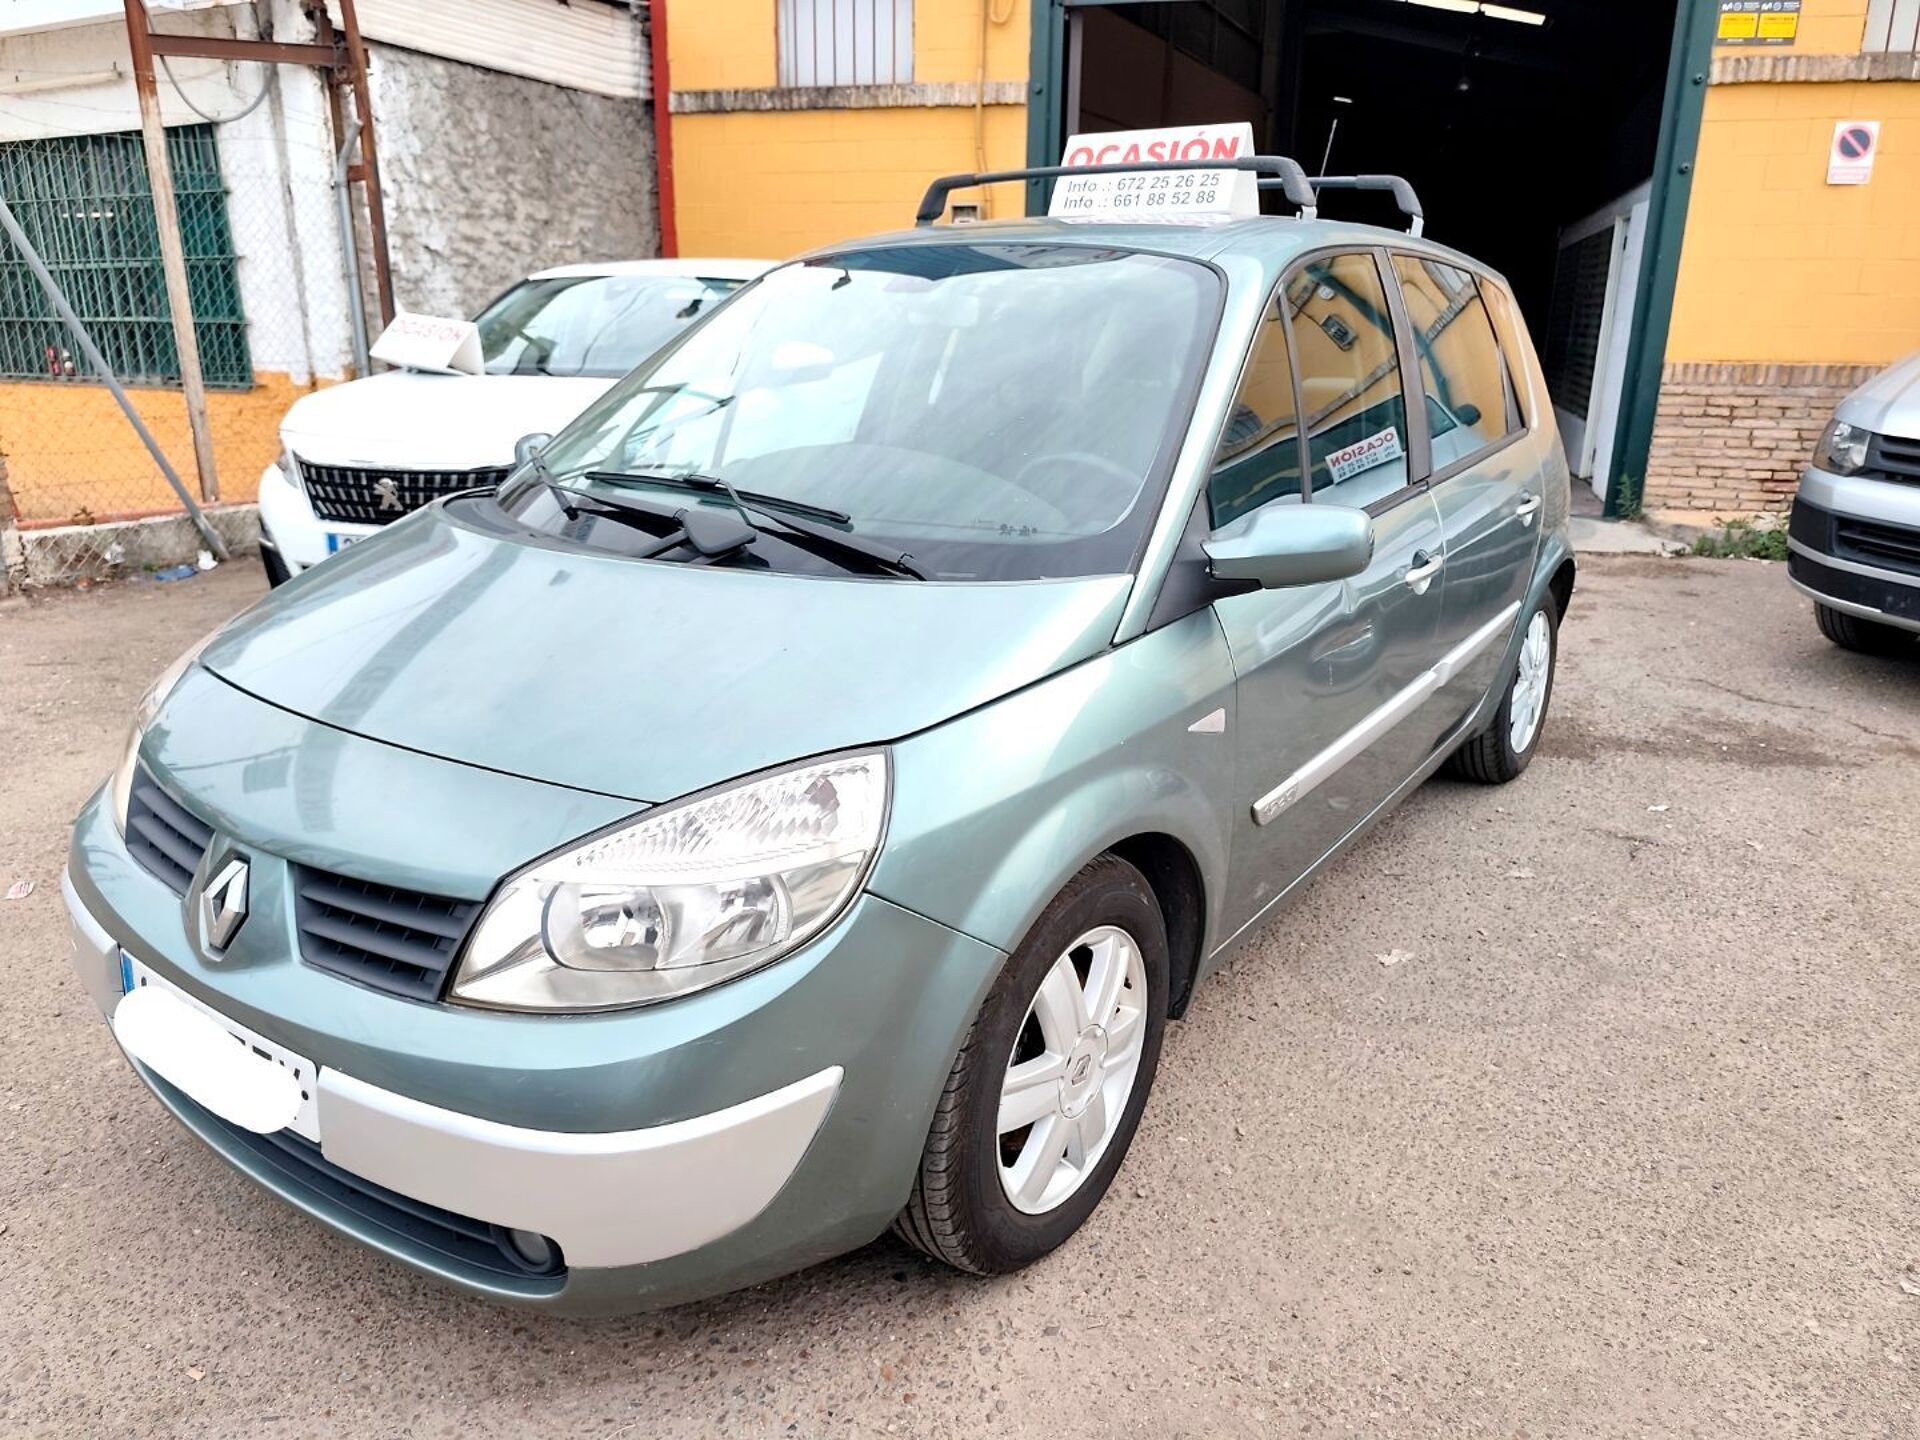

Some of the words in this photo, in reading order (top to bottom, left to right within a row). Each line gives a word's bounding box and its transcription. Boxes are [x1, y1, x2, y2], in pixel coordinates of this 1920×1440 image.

[1067, 131, 1240, 167] OCASIÓN
[1067, 179, 1097, 192] Info
[1117, 176, 1146, 191] 672
[1150, 176, 1170, 189] 25
[1175, 174, 1195, 188] 26
[1200, 173, 1220, 186] 25
[1063, 195, 1093, 209] Info
[1113, 193, 1141, 207] 661
[1146, 192, 1166, 206] 88
[1171, 191, 1191, 205] 52
[1195, 190, 1216, 204] 88
